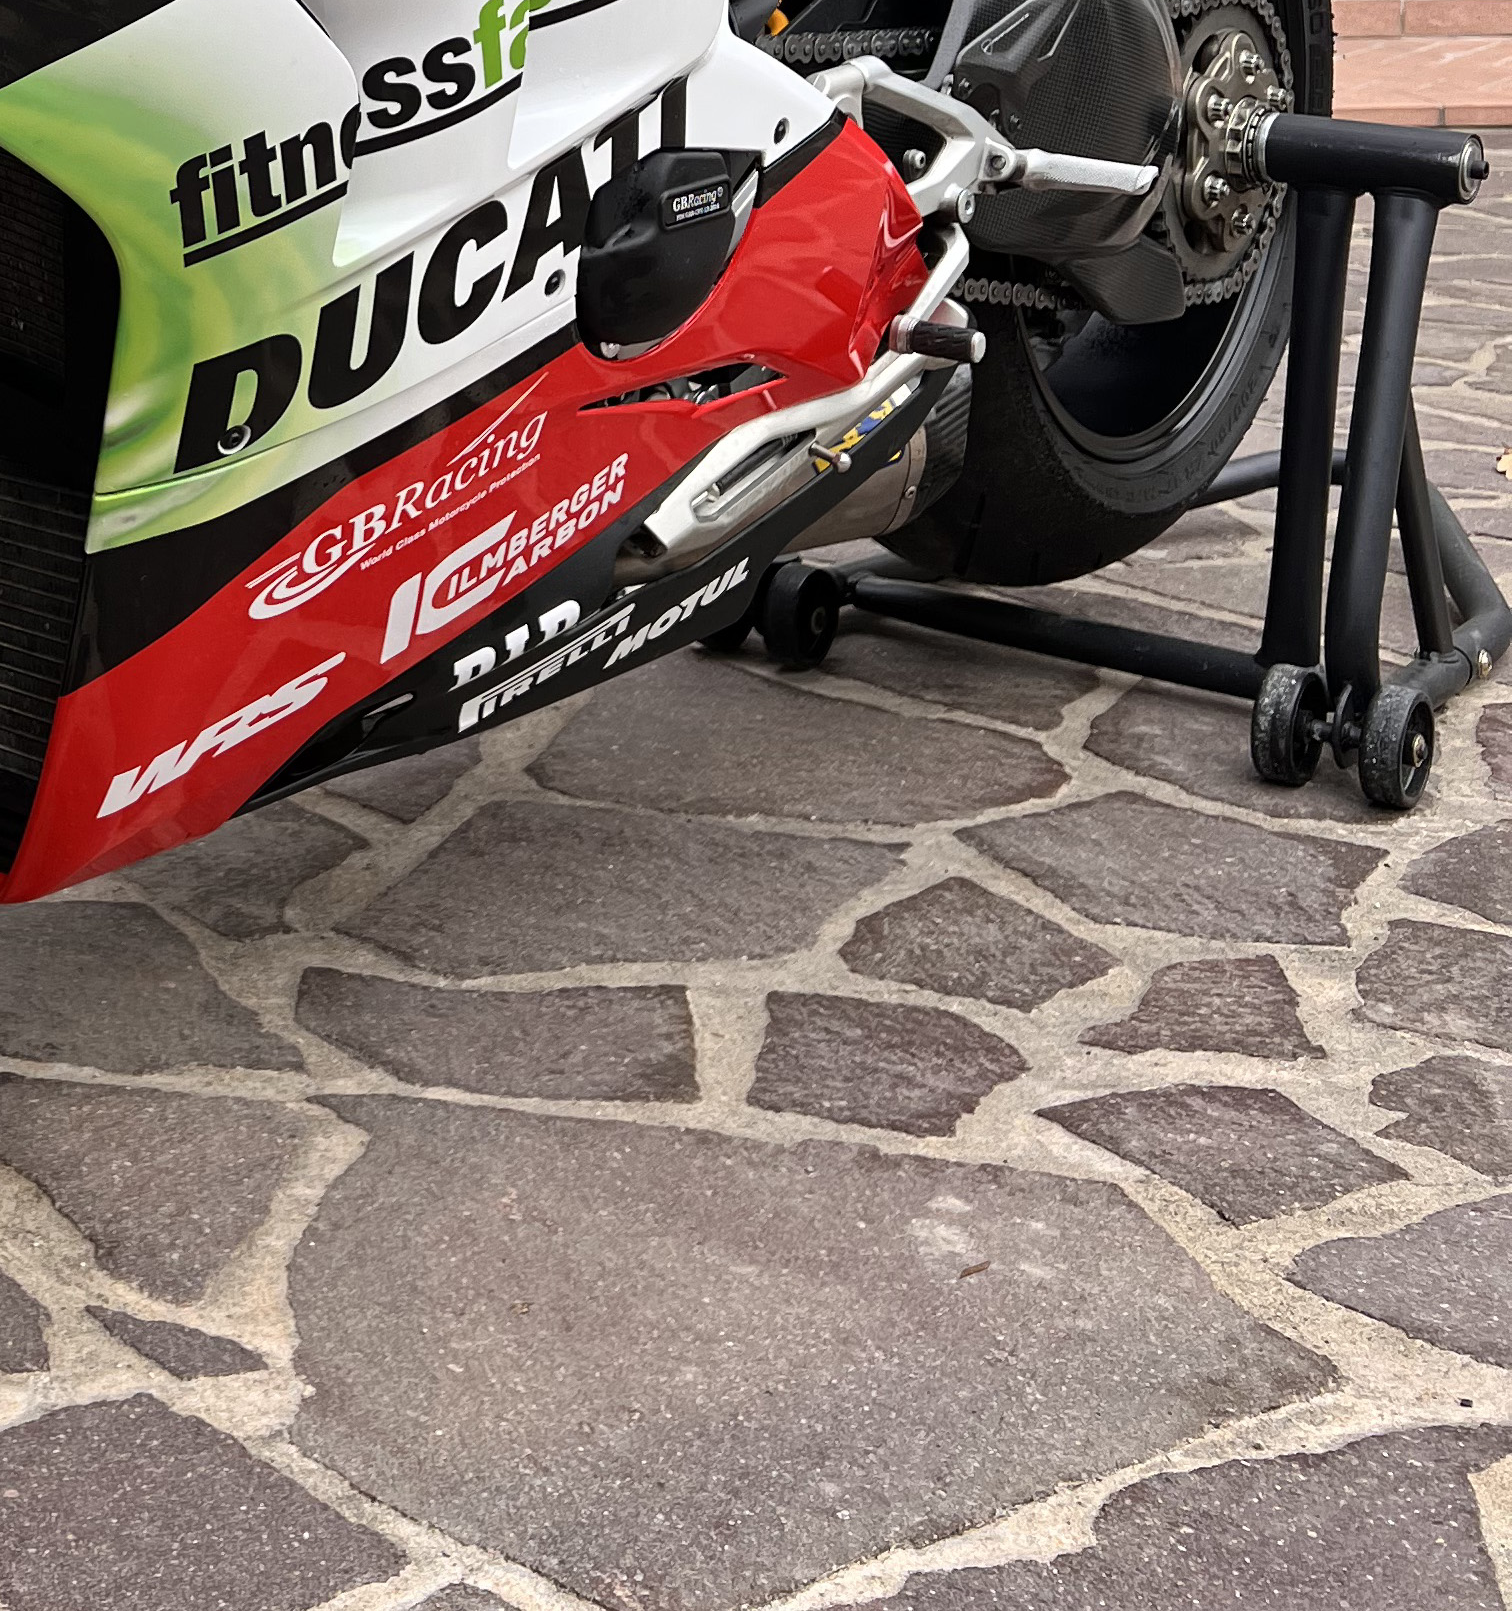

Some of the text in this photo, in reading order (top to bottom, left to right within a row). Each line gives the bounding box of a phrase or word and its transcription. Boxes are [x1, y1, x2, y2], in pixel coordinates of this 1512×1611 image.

[302, 411, 549, 575] GBRacing
[360, 453, 541, 570] World Class Motorcycle Protection
[446, 452, 630, 601] ILMBERGER
[458, 602, 636, 733] PIRELLI
[602, 557, 750, 670] MOTUL
[96, 651, 347, 819] WRS
